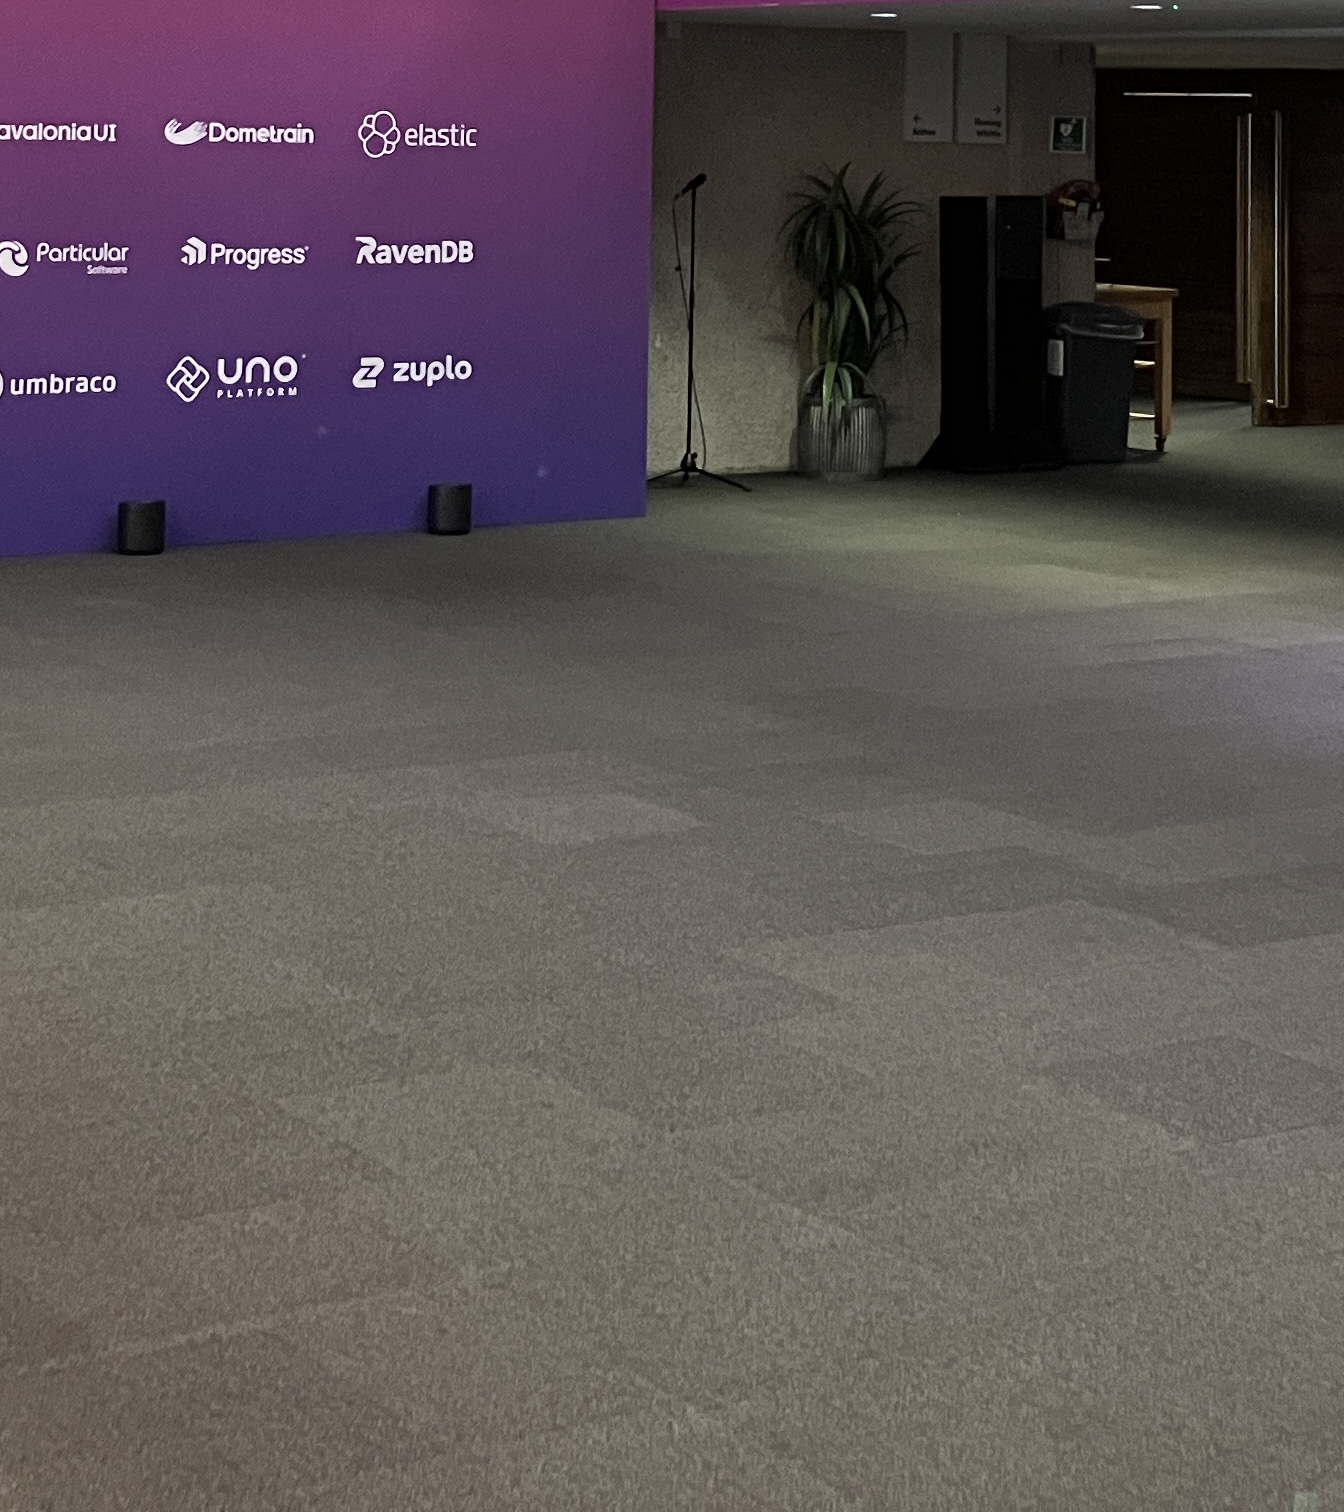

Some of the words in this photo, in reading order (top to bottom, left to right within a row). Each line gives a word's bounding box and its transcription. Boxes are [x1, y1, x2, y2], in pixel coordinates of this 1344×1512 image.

[209, 123, 314, 143] Dometrain
[405, 124, 477, 146] elastic
[37, 243, 129, 263] Particular
[211, 244, 306, 270] Progress
[356, 237, 473, 264] RavenDB
[393, 355, 472, 386] zuplo
[11, 374, 116, 395] umbraco
[217, 387, 297, 398] PLATFORM
